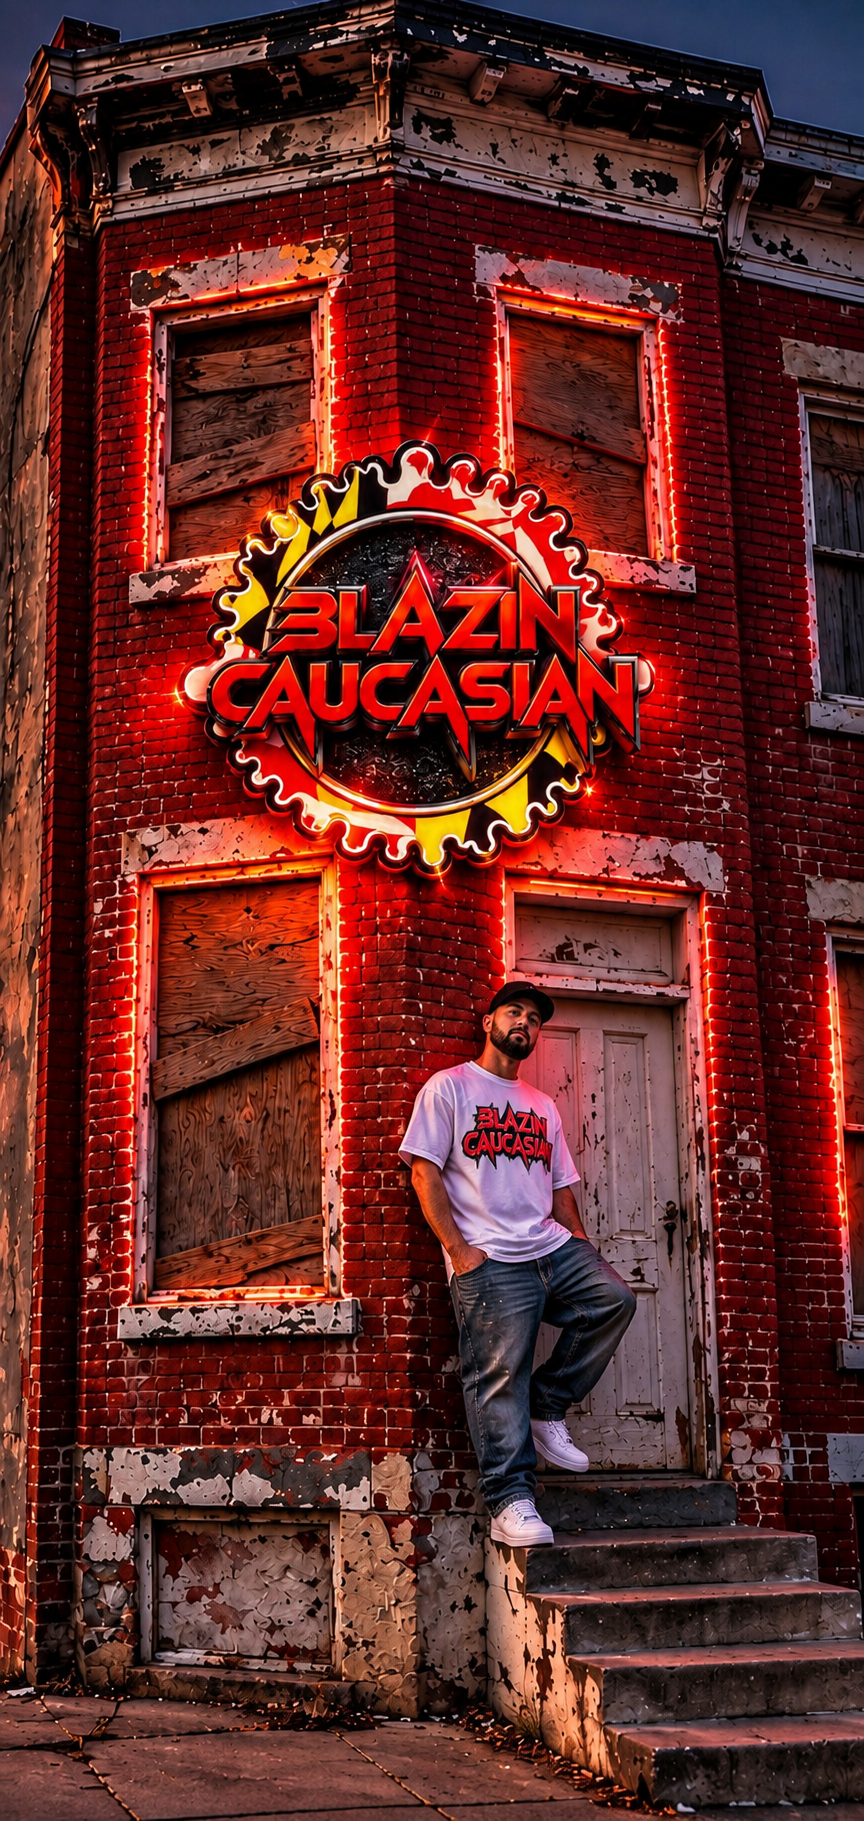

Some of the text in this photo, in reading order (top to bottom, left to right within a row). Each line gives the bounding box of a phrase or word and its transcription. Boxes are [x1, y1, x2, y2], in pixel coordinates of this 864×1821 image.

[265, 558, 581, 663] BLAZIN
[208, 653, 640, 776] CAUCASIAN
[462, 1129, 553, 1173] CAUCASIAN
[474, 1103, 547, 1138] BLAZIN
